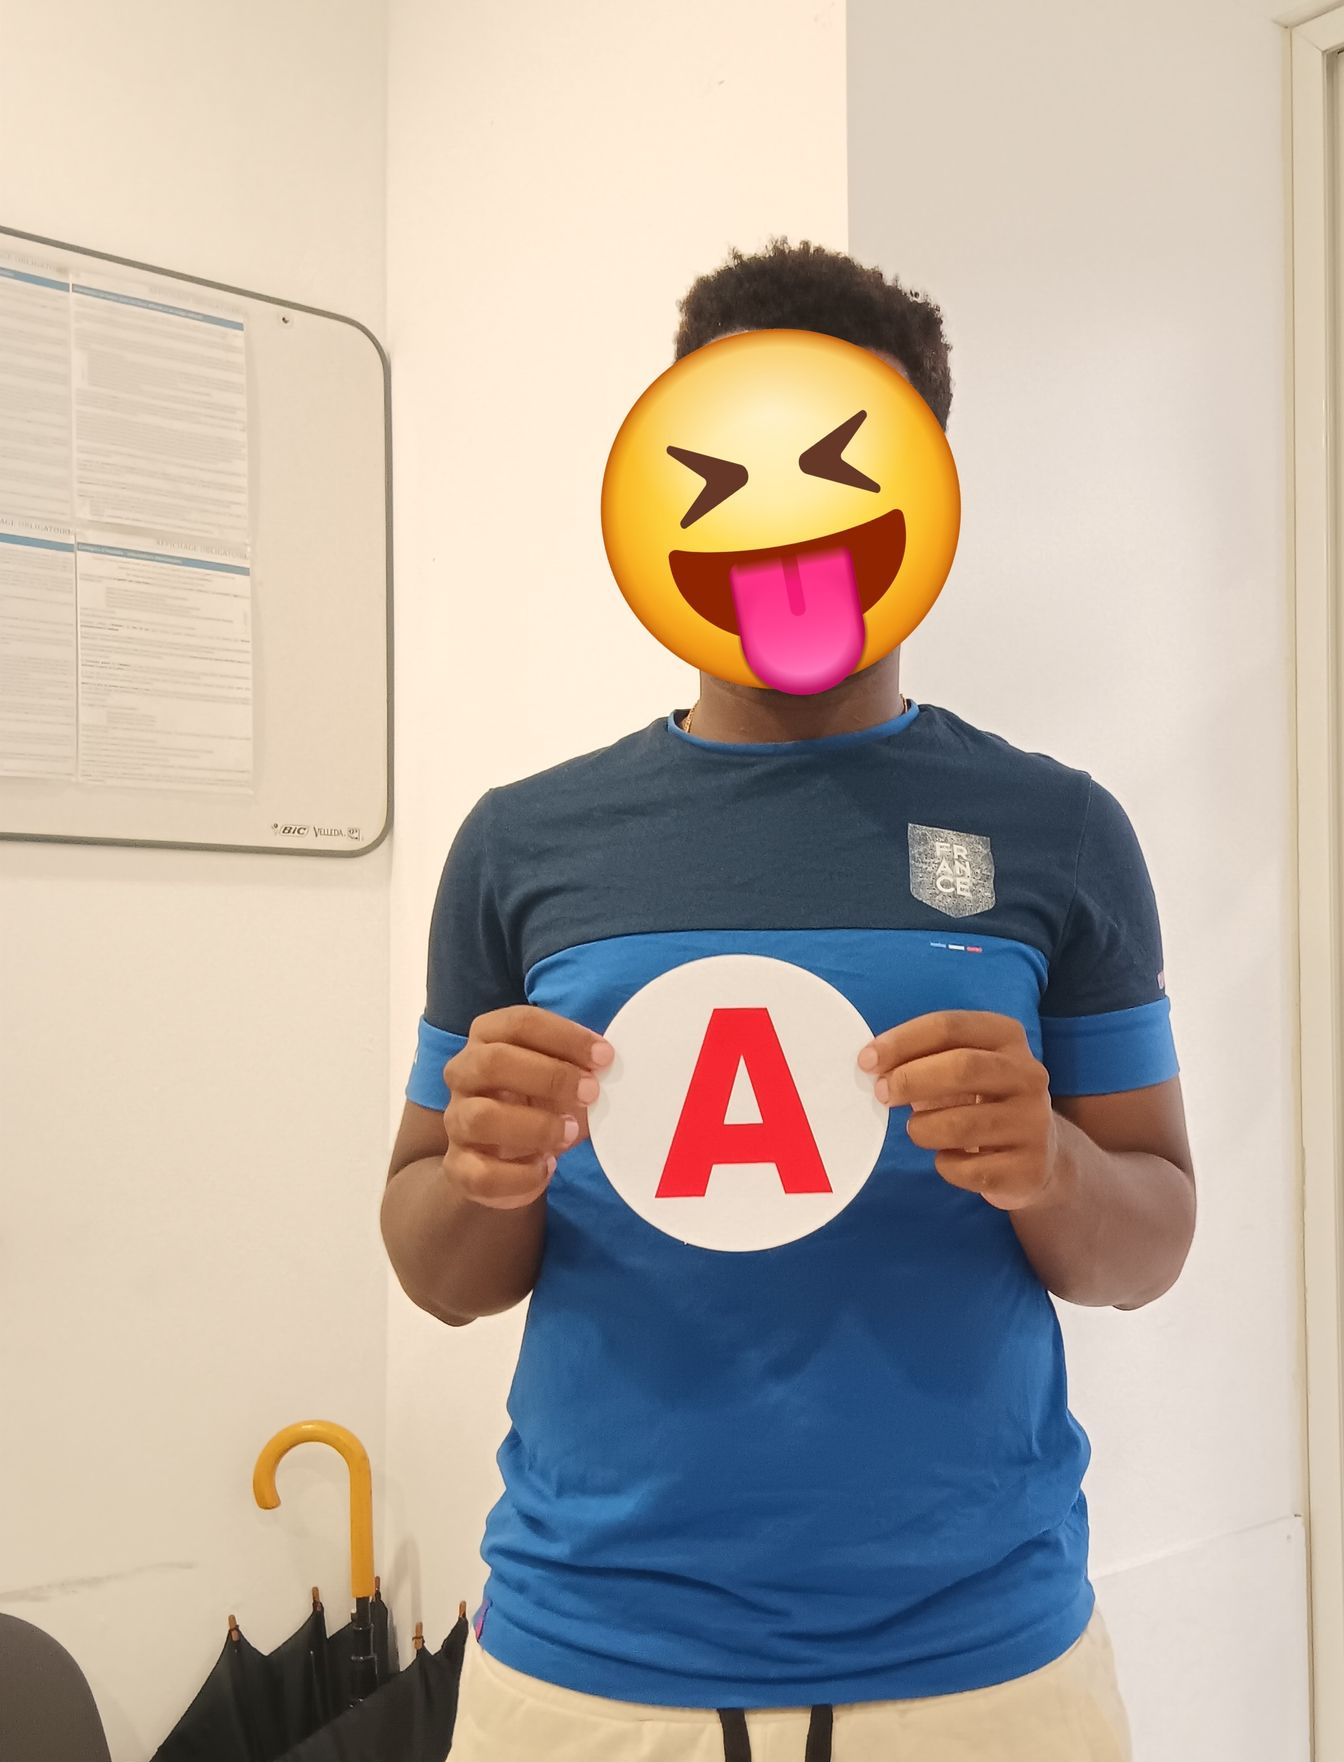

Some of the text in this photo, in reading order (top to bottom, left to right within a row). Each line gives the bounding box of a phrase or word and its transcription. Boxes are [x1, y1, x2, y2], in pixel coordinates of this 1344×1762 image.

[281, 826, 307, 836] BIC
[935, 842, 968, 860] FR
[936, 875, 972, 898] CE
[655, 1007, 833, 1198] A
